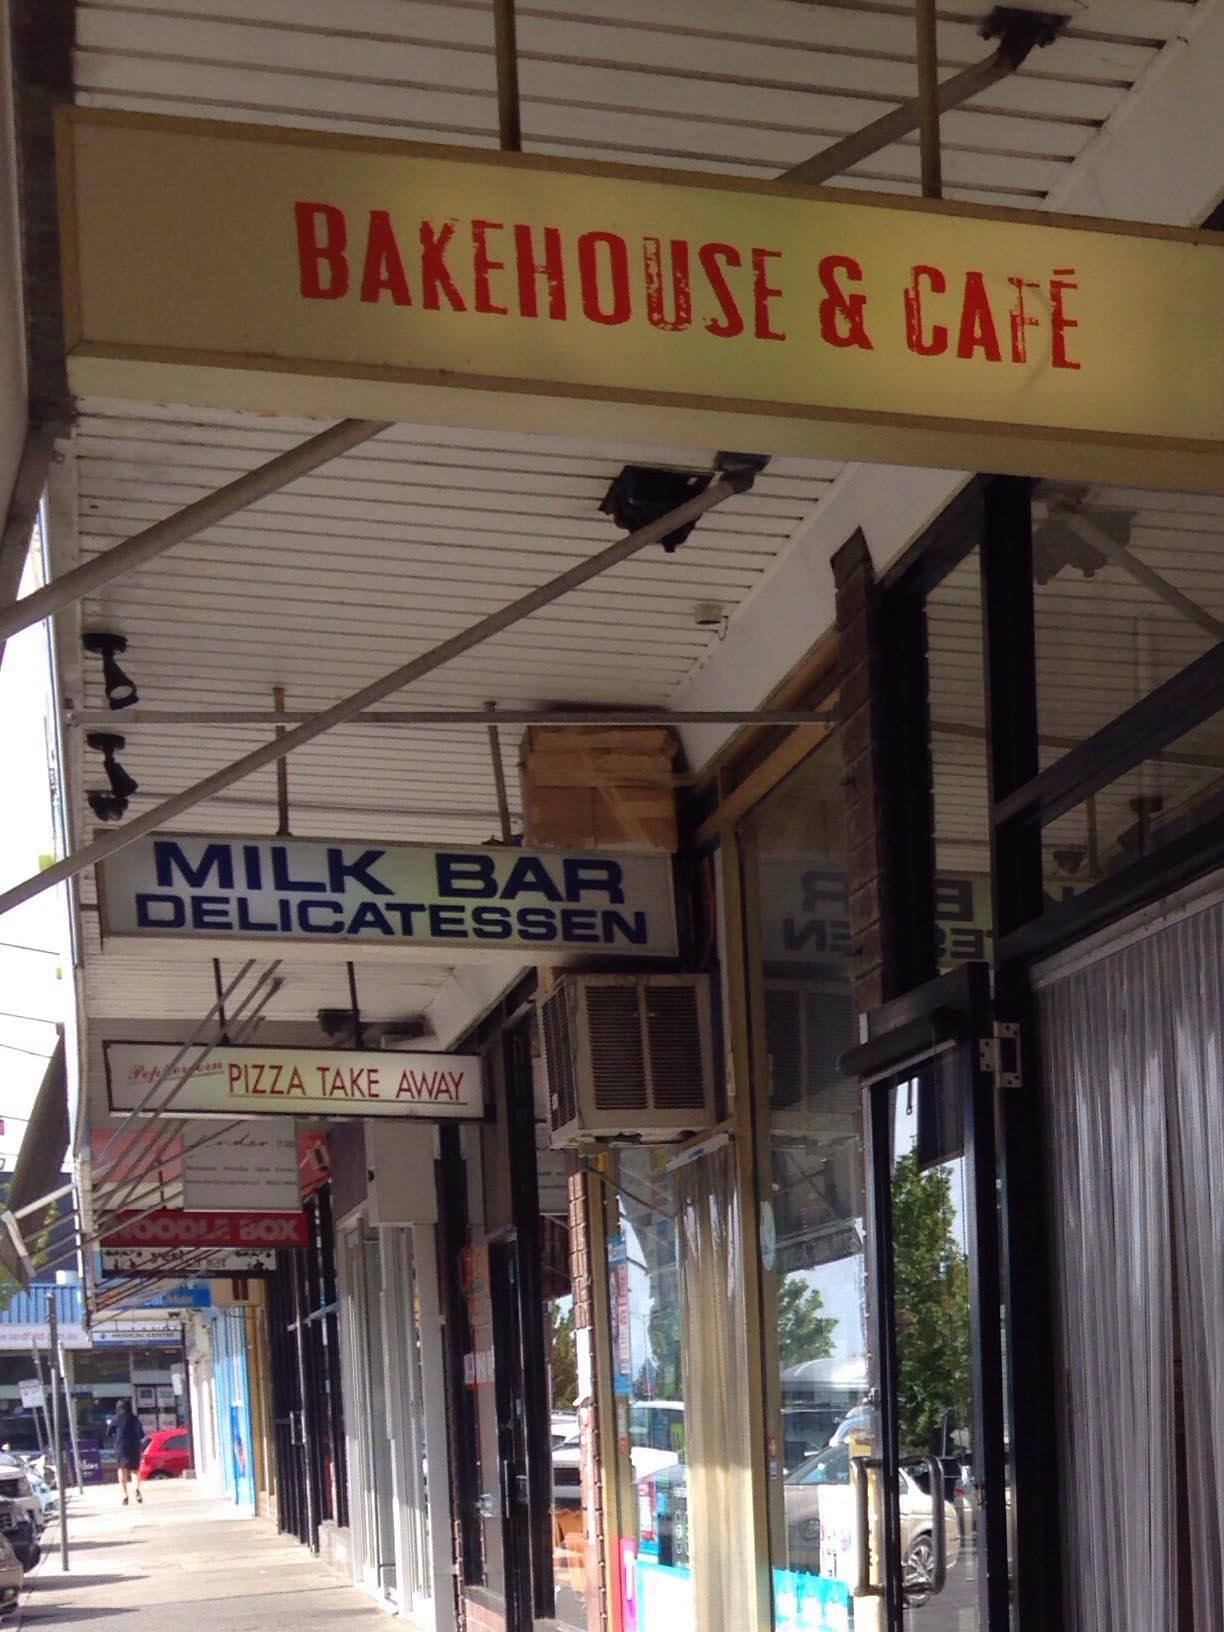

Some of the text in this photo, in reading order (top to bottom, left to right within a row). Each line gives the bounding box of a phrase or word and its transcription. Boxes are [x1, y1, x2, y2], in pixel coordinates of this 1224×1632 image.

[294, 200, 787, 342] BAKEHOUSE
[818, 253, 874, 351] &
[154, 840, 625, 904] MILK BAR
[135, 893, 648, 944] DELICATESSEN
[228, 1063, 306, 1097] PIZZA
[316, 1066, 380, 1099] TAKE
[395, 1070, 465, 1102] AWAY
[239, 1219, 299, 1241] BOX
